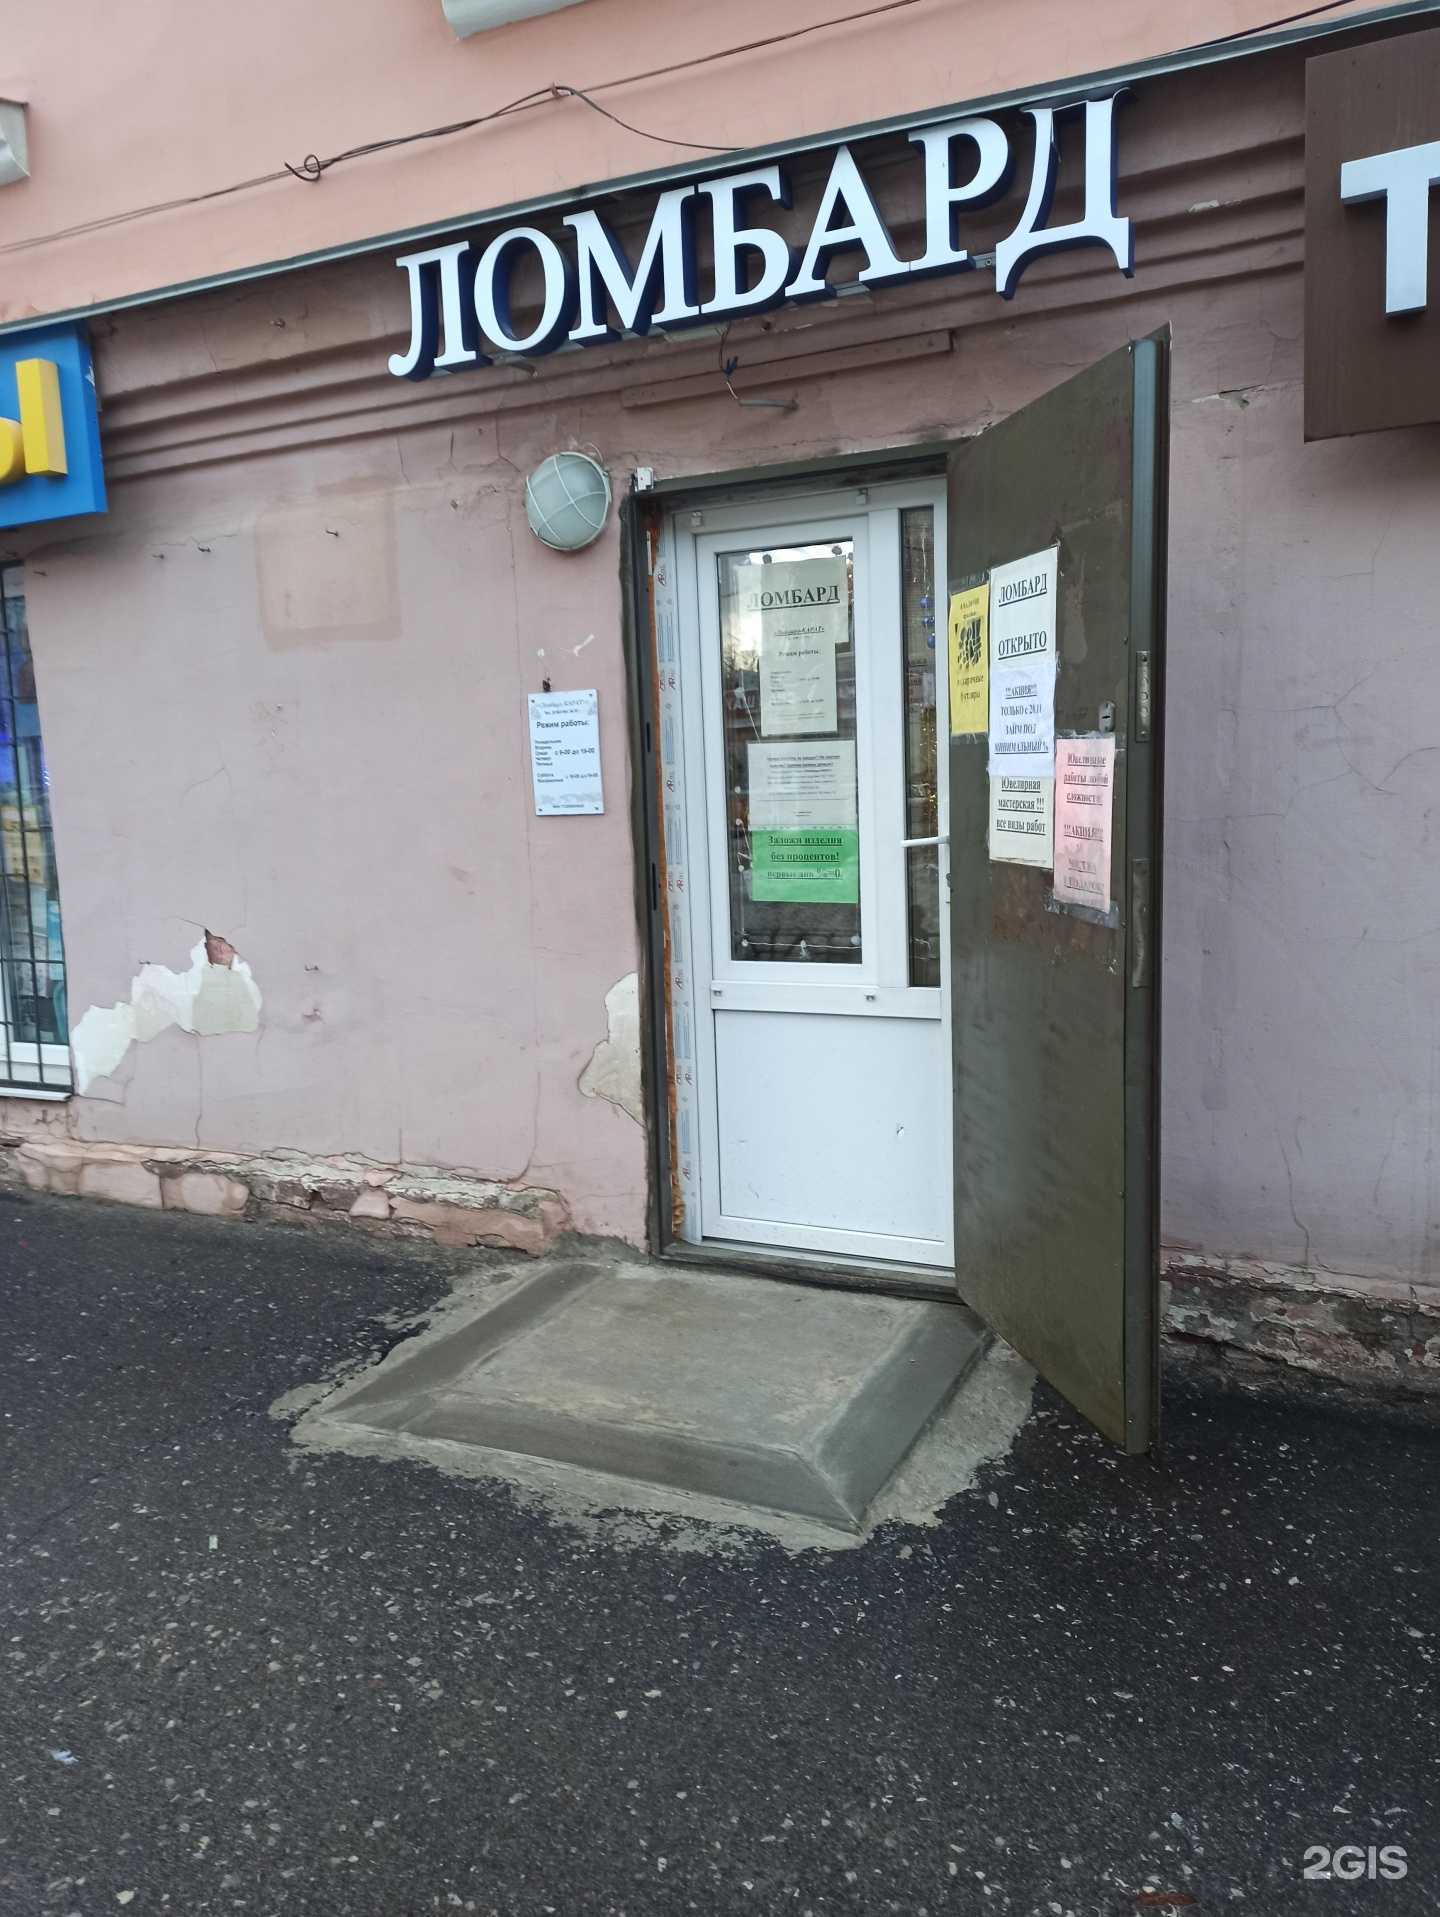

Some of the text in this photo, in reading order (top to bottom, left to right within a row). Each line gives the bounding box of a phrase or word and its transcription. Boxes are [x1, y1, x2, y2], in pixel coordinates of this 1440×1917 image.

[388, 97, 1131, 377] ЛОМБАРД
[747, 585, 840, 608] ЛОМБАРД
[999, 573, 1047, 603] ЛОМБАРД
[998, 630, 1047, 656] ОТКРЫТО
[1001, 776, 1041, 791] Ювелирная
[998, 799, 1035, 810] мастерская
[996, 819, 1046, 833] все виды работ
[770, 851, 839, 862] без процентов!
